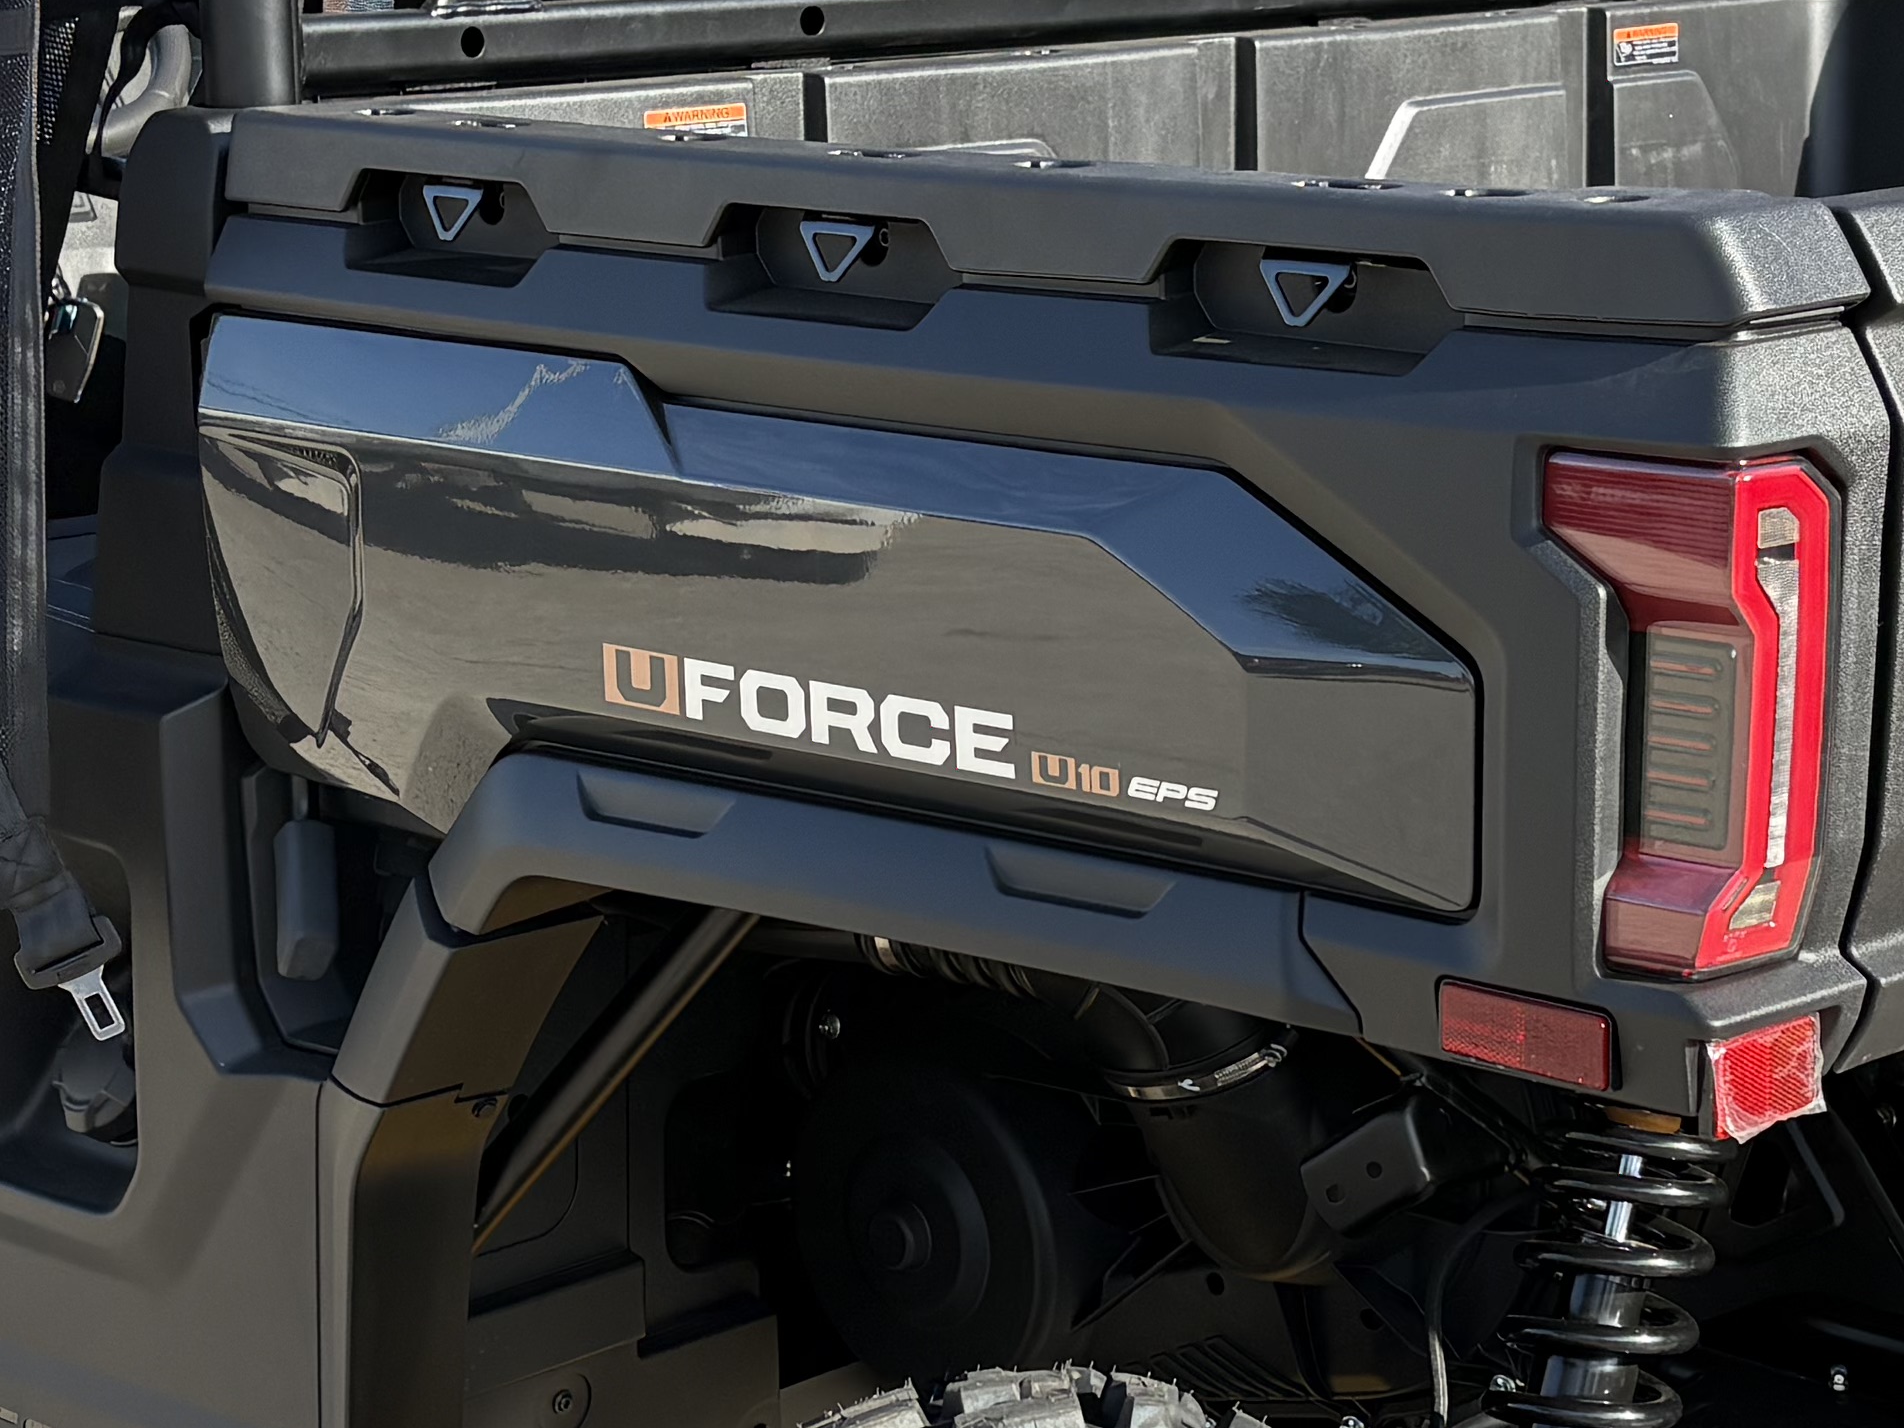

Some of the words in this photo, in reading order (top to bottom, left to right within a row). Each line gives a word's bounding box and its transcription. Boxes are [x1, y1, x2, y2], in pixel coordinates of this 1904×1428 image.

[673, 106, 730, 123] WARNING
[602, 642, 1016, 780] UFORCE
[1031, 750, 1121, 798] U10
[1126, 776, 1220, 813] EPS
